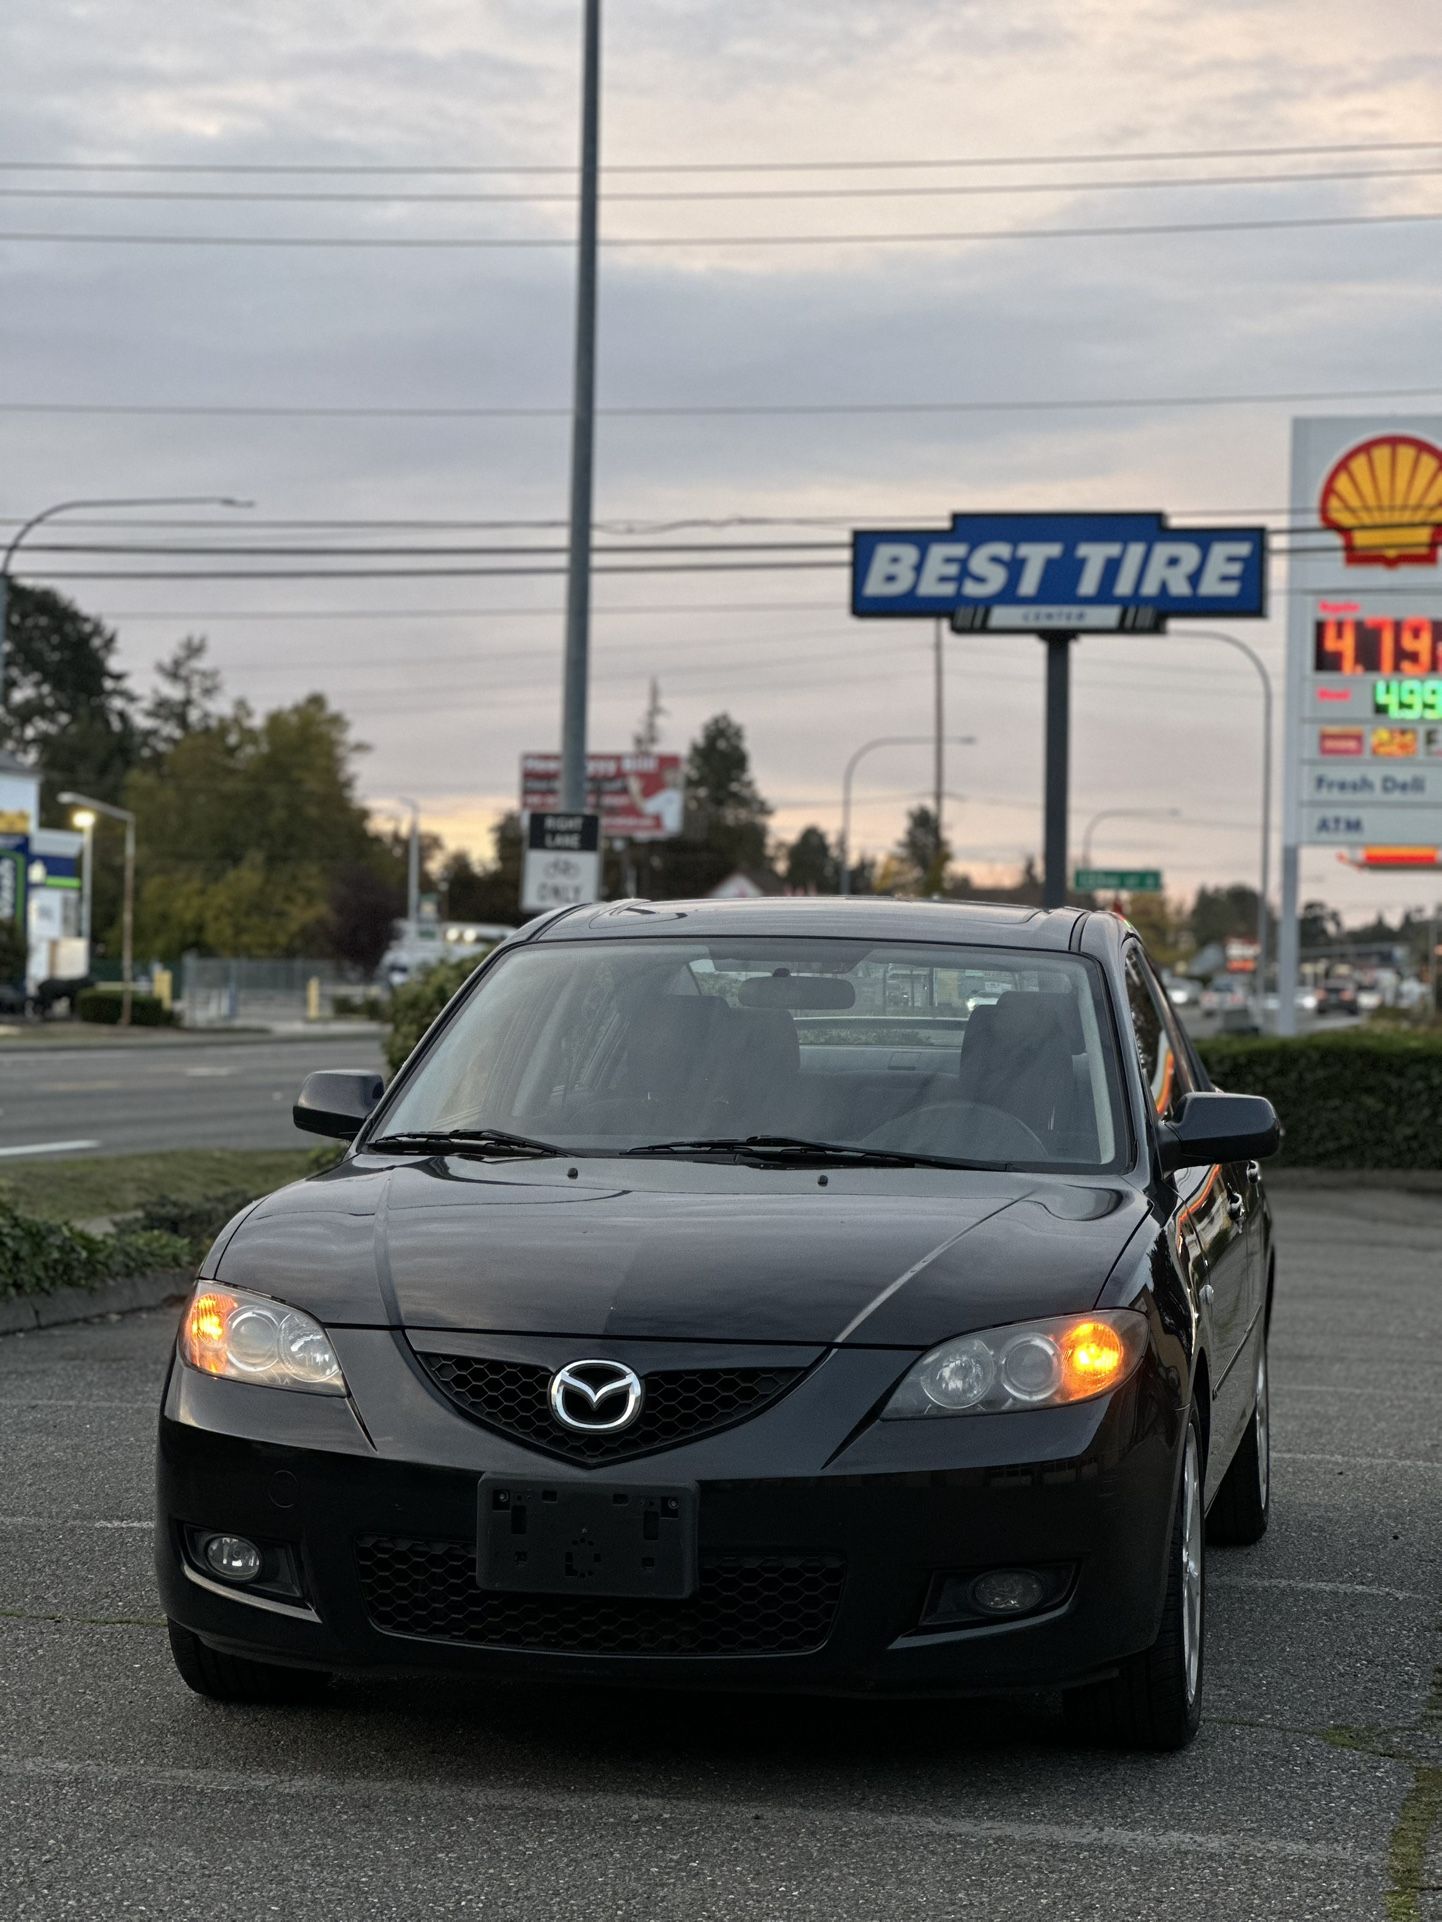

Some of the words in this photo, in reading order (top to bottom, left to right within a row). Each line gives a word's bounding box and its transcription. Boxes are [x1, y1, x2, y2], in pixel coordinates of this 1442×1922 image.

[861, 541, 1065, 598] BEST
[1073, 541, 1254, 598] TIRE
[1315, 773, 1375, 794] Fresh
[1381, 773, 1426, 794] Deli
[1316, 816, 1363, 833] ATM
